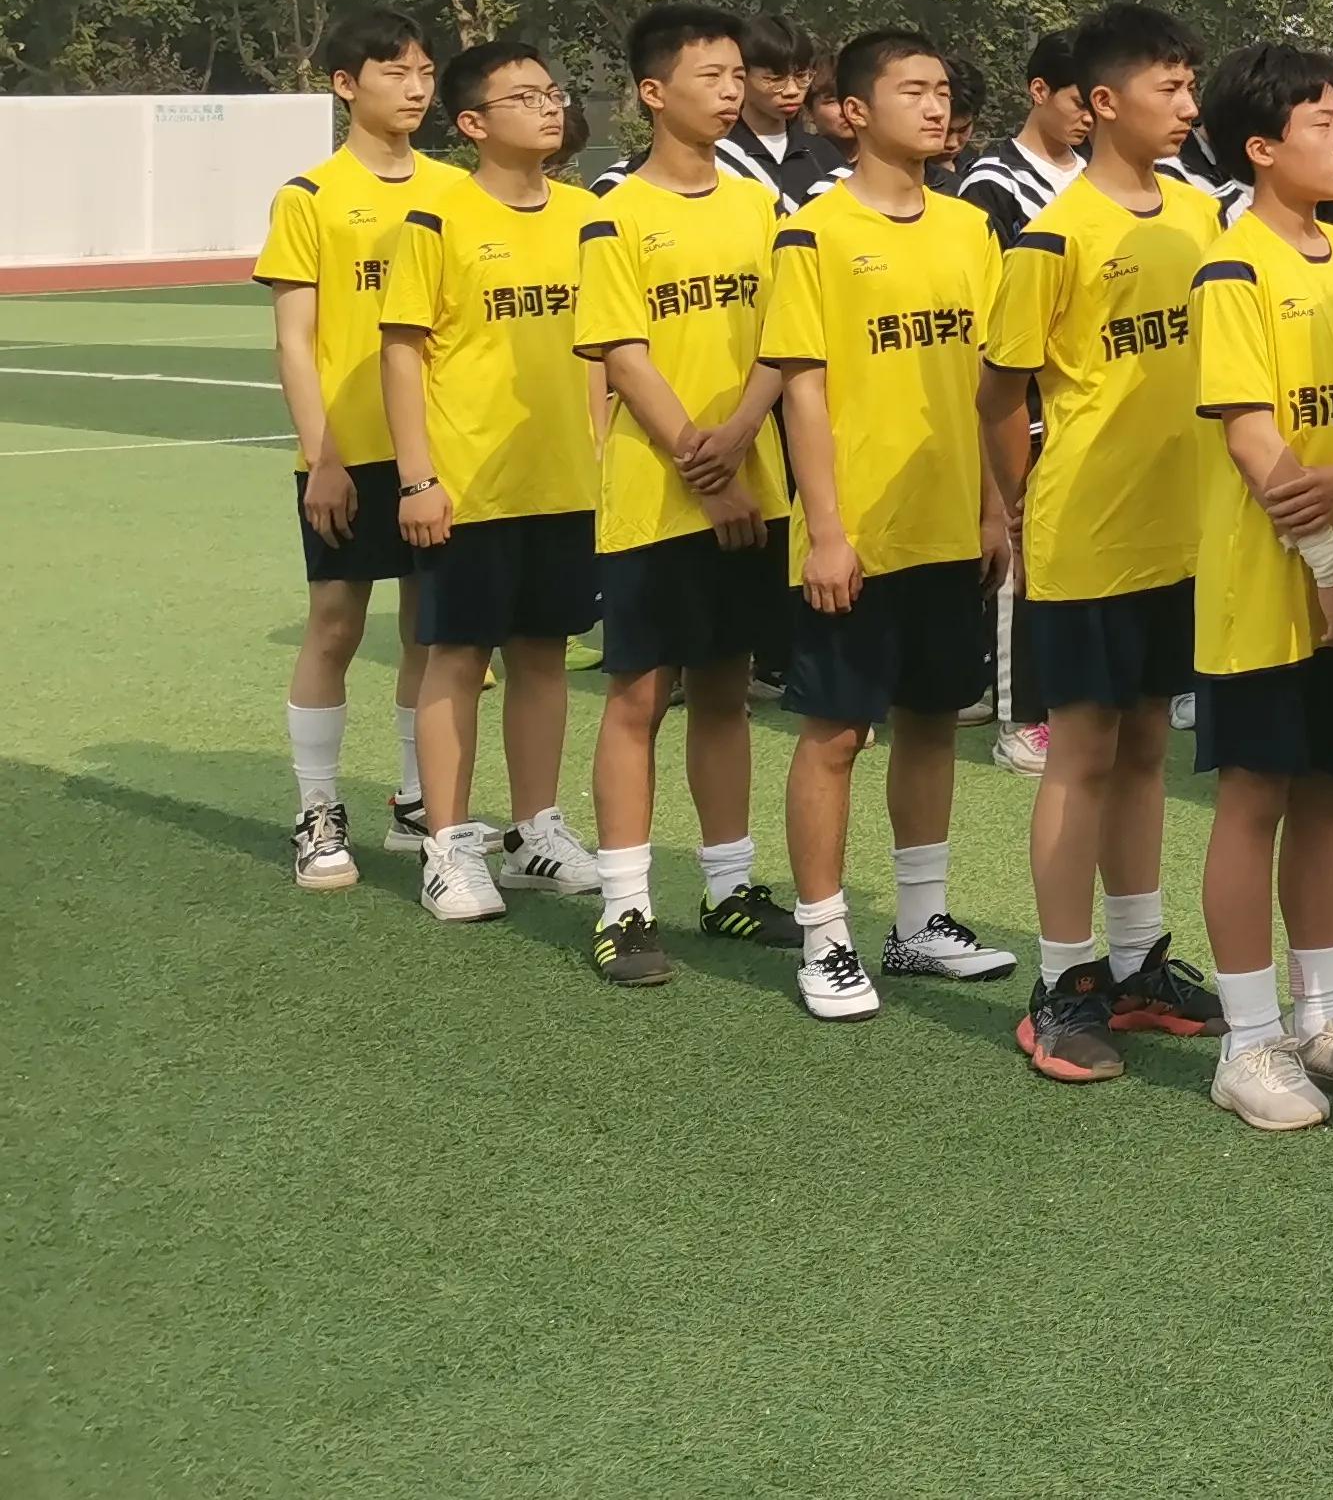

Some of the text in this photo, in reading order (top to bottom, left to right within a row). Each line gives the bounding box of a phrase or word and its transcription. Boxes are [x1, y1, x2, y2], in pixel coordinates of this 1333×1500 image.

[1103, 265, 1140, 281] SUNAIS
[1281, 308, 1315, 320] SUNAIS
[450, 830, 475, 840] adidas
